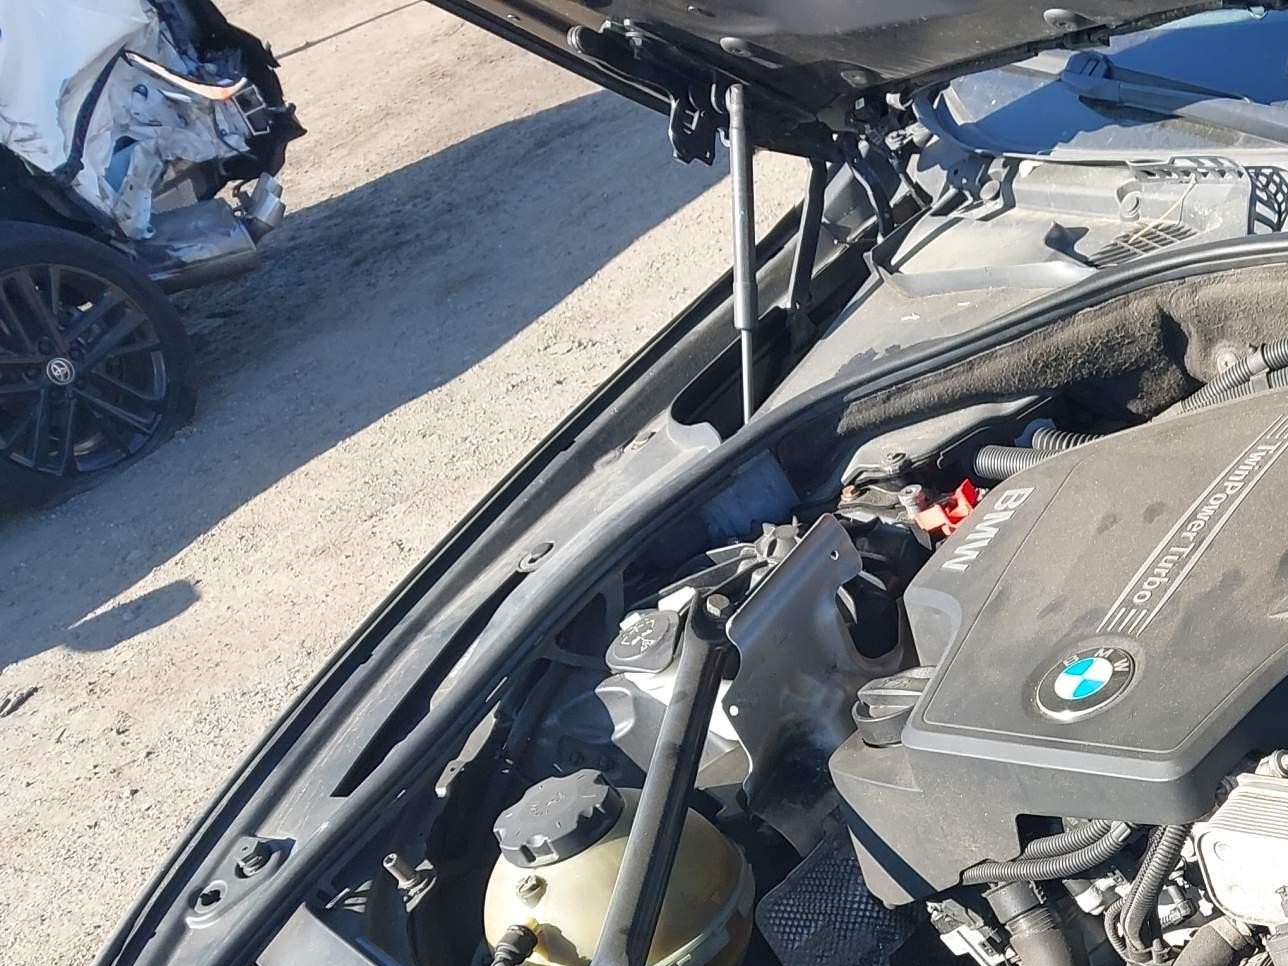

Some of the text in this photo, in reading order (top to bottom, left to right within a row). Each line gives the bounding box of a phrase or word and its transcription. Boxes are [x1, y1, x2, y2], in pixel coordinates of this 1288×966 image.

[942, 487, 1035, 572] BMW
[1133, 441, 1283, 604] TwinPower Turbo
